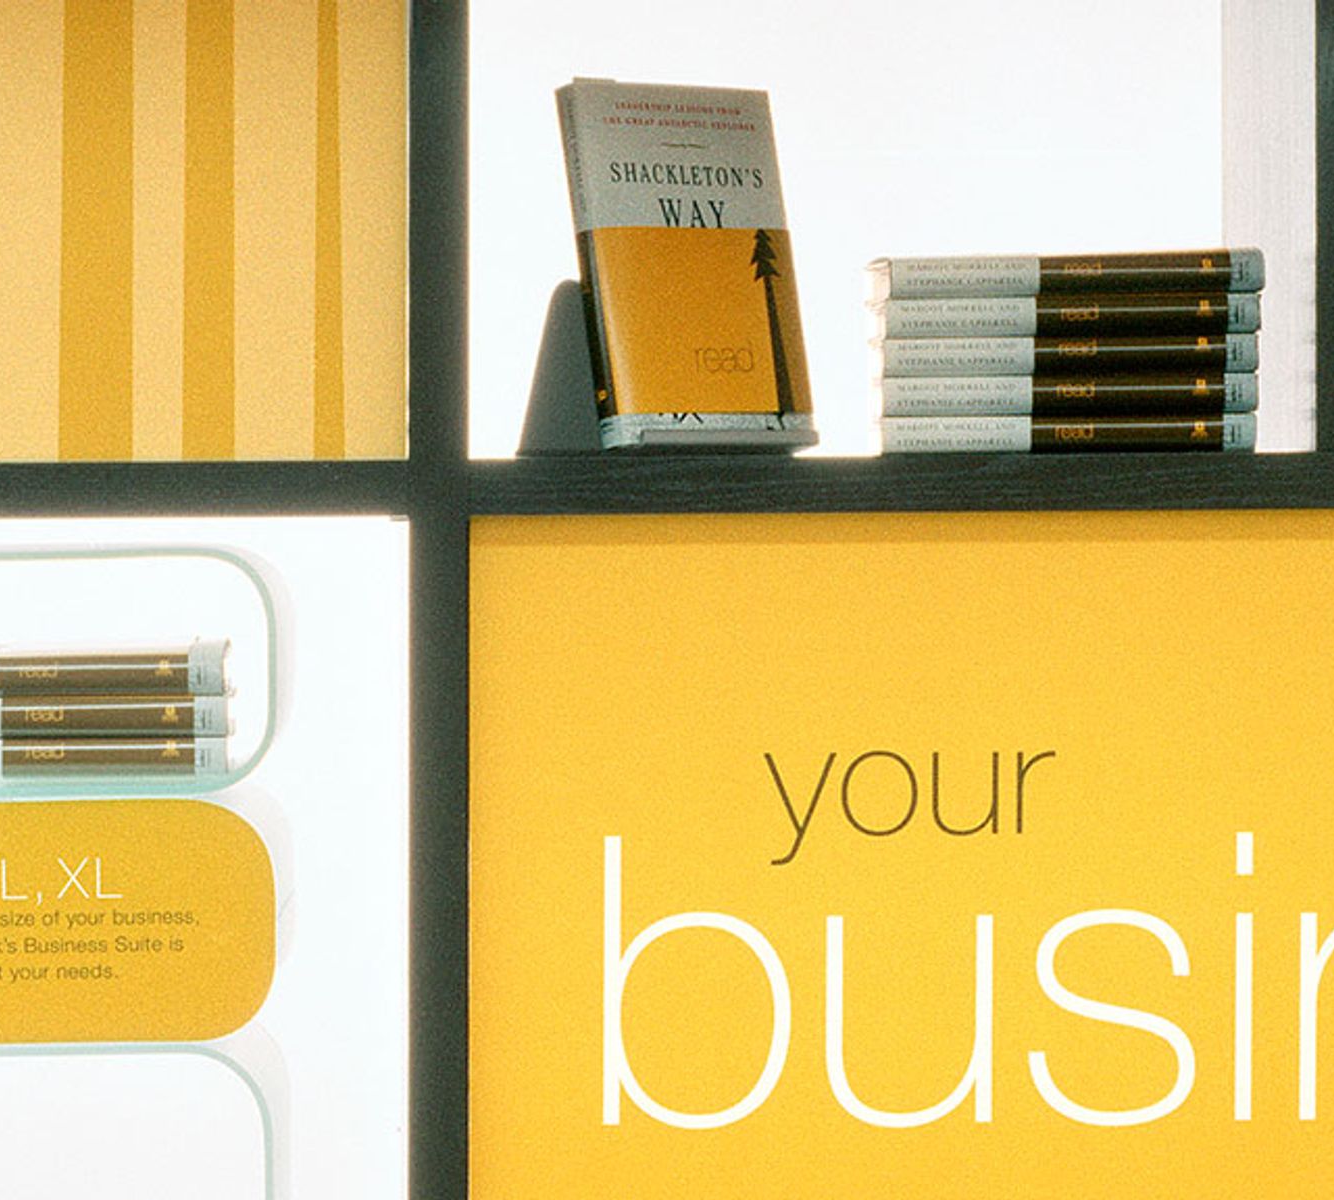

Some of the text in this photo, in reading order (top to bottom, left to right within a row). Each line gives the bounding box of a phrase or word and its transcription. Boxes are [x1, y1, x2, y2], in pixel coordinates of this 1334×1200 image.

[610, 162, 763, 189] SHACKLETON'S
[658, 198, 725, 228] WAY
[1066, 261, 1102, 275] read
[1061, 304, 1099, 321] read
[695, 339, 754, 374] read
[1058, 340, 1097, 356] read
[1056, 381, 1096, 398] read
[1055, 423, 1094, 440] read
[18, 662, 59, 679] read
[24, 705, 65, 723] read
[24, 745, 66, 762] read
[762, 751, 1057, 866] your
[0, 858, 44, 904] L,
[57, 857, 123, 900] XL
[0, 911, 35, 927] size
[42, 911, 60, 927] of
[66, 915, 105, 931] your
[112, 910, 199, 929] business,
[24, 937, 108, 954] Business
[115, 936, 163, 953] Suite
[169, 936, 184, 952] is
[10, 968, 48, 985] your
[56, 963, 118, 980] needs.
